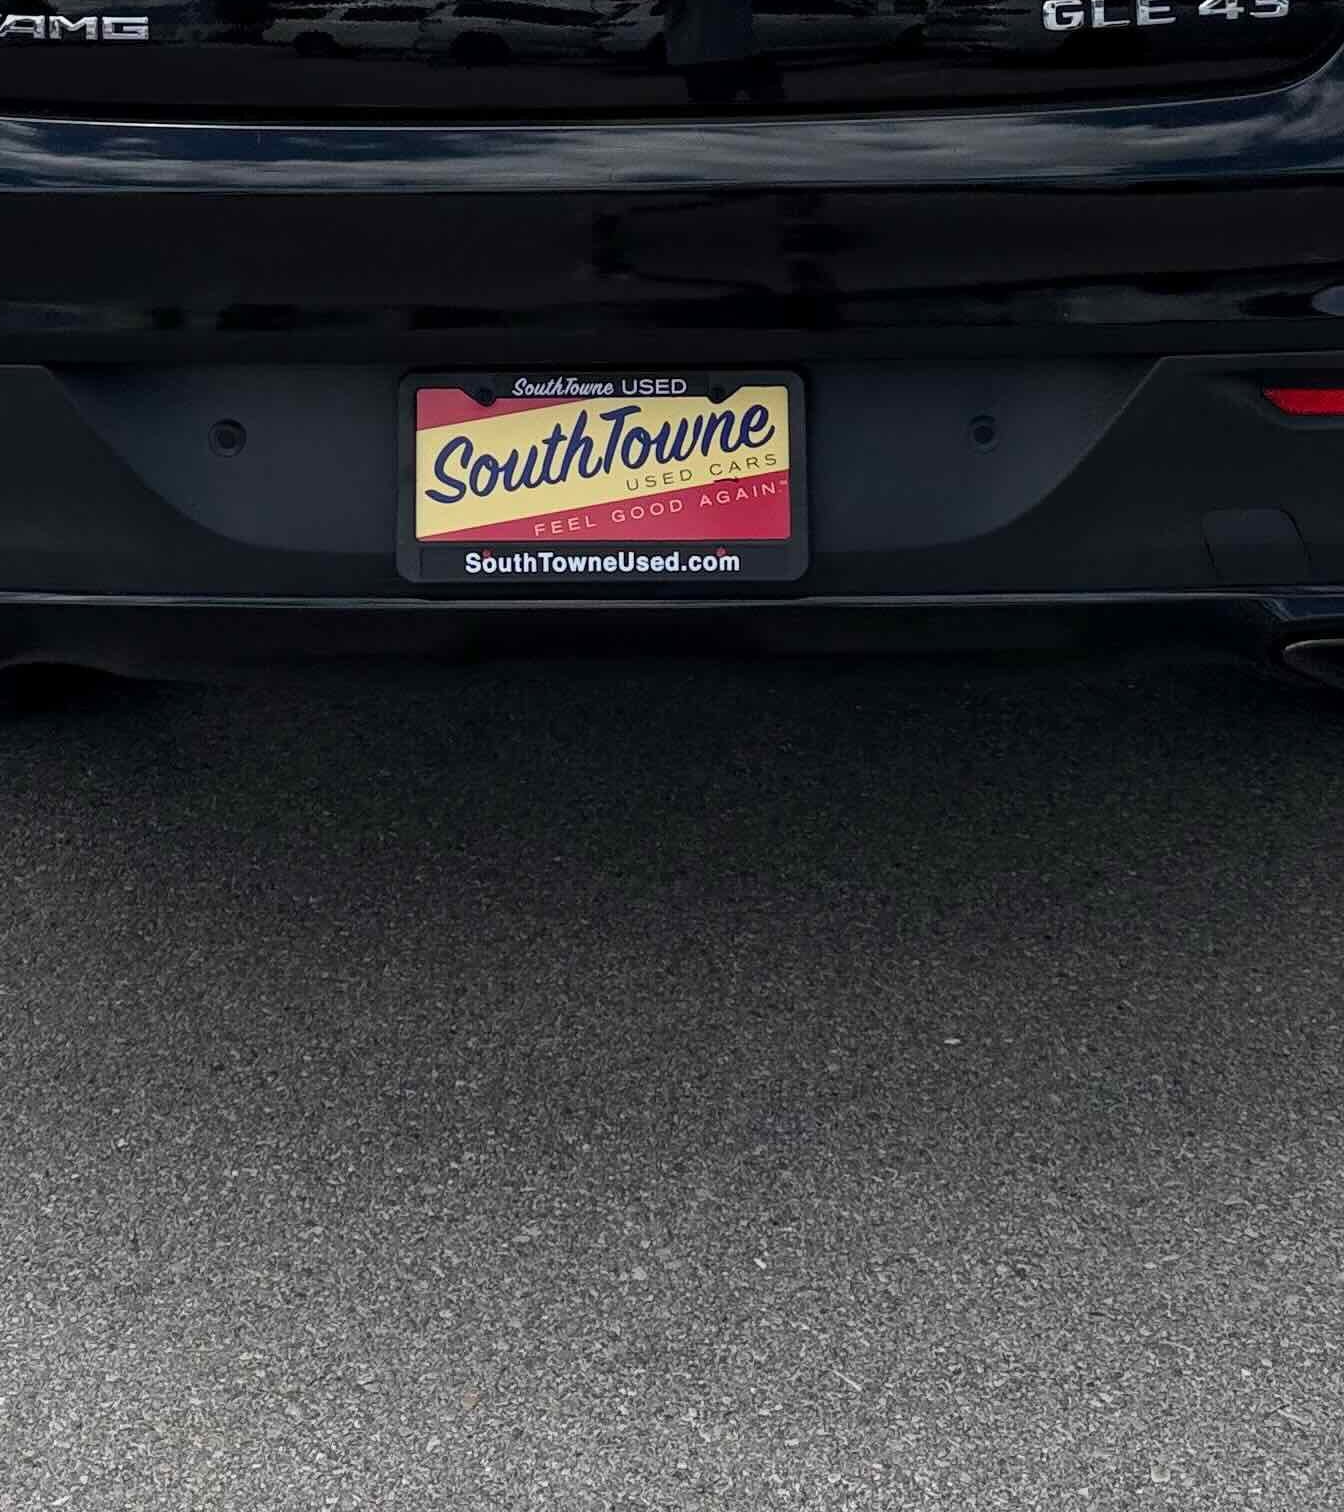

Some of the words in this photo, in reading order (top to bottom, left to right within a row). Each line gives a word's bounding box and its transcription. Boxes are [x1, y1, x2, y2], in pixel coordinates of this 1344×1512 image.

[511, 375, 616, 397] SouthTowne
[620, 378, 688, 396] USED
[424, 404, 776, 505] SouthTowne
[625, 469, 694, 492] USED
[708, 453, 778, 476] CARS
[533, 515, 598, 538] FEEL
[610, 498, 684, 524] GOOD
[464, 550, 741, 575] SouthTowneUsed.com
